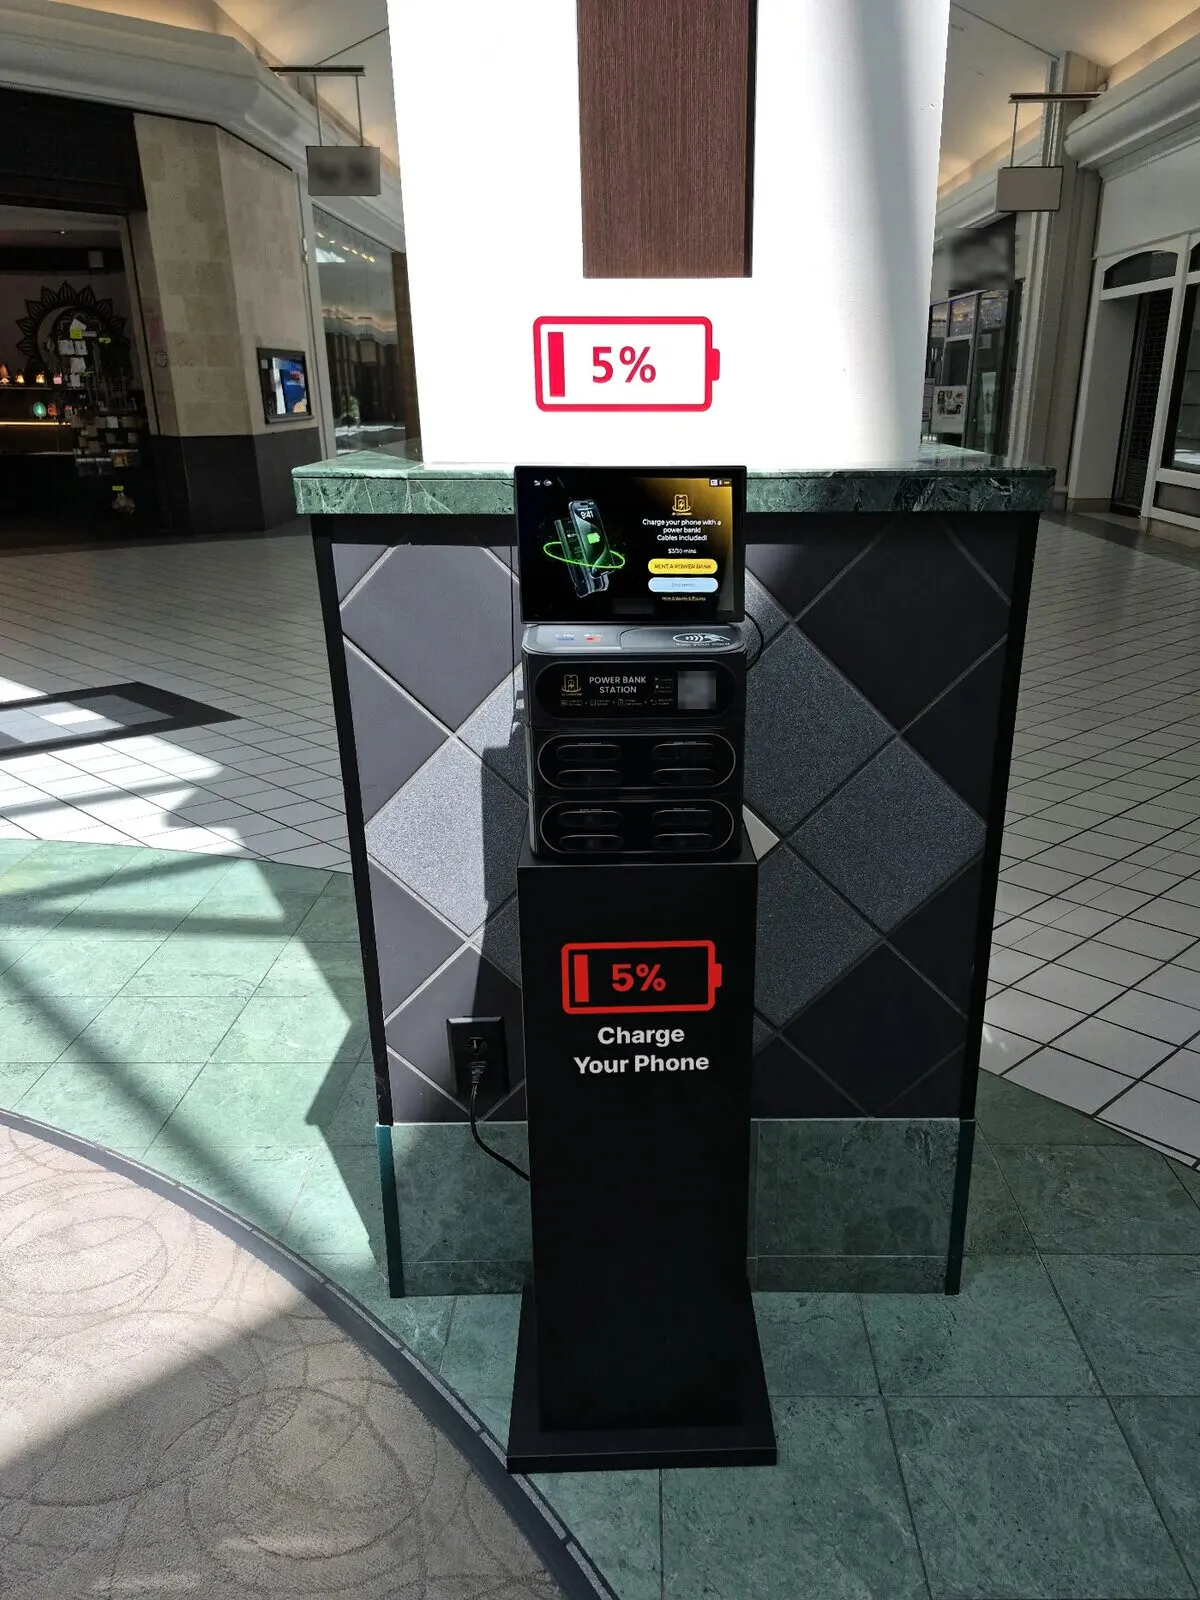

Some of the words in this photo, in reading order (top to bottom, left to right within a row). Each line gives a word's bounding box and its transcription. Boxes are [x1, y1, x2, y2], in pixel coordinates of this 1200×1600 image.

[592, 346, 657, 384] 5%
[642, 518, 665, 527] Charge
[665, 519, 680, 527] your
[681, 519, 701, 527] phone
[589, 675, 621, 685] POWER
[622, 675, 647, 684] BANK
[599, 685, 637, 694] STATION
[611, 963, 667, 992] 5%
[597, 1026, 685, 1047] Charge
[573, 1056, 629, 1075] Your
[634, 1054, 710, 1072] Phone
